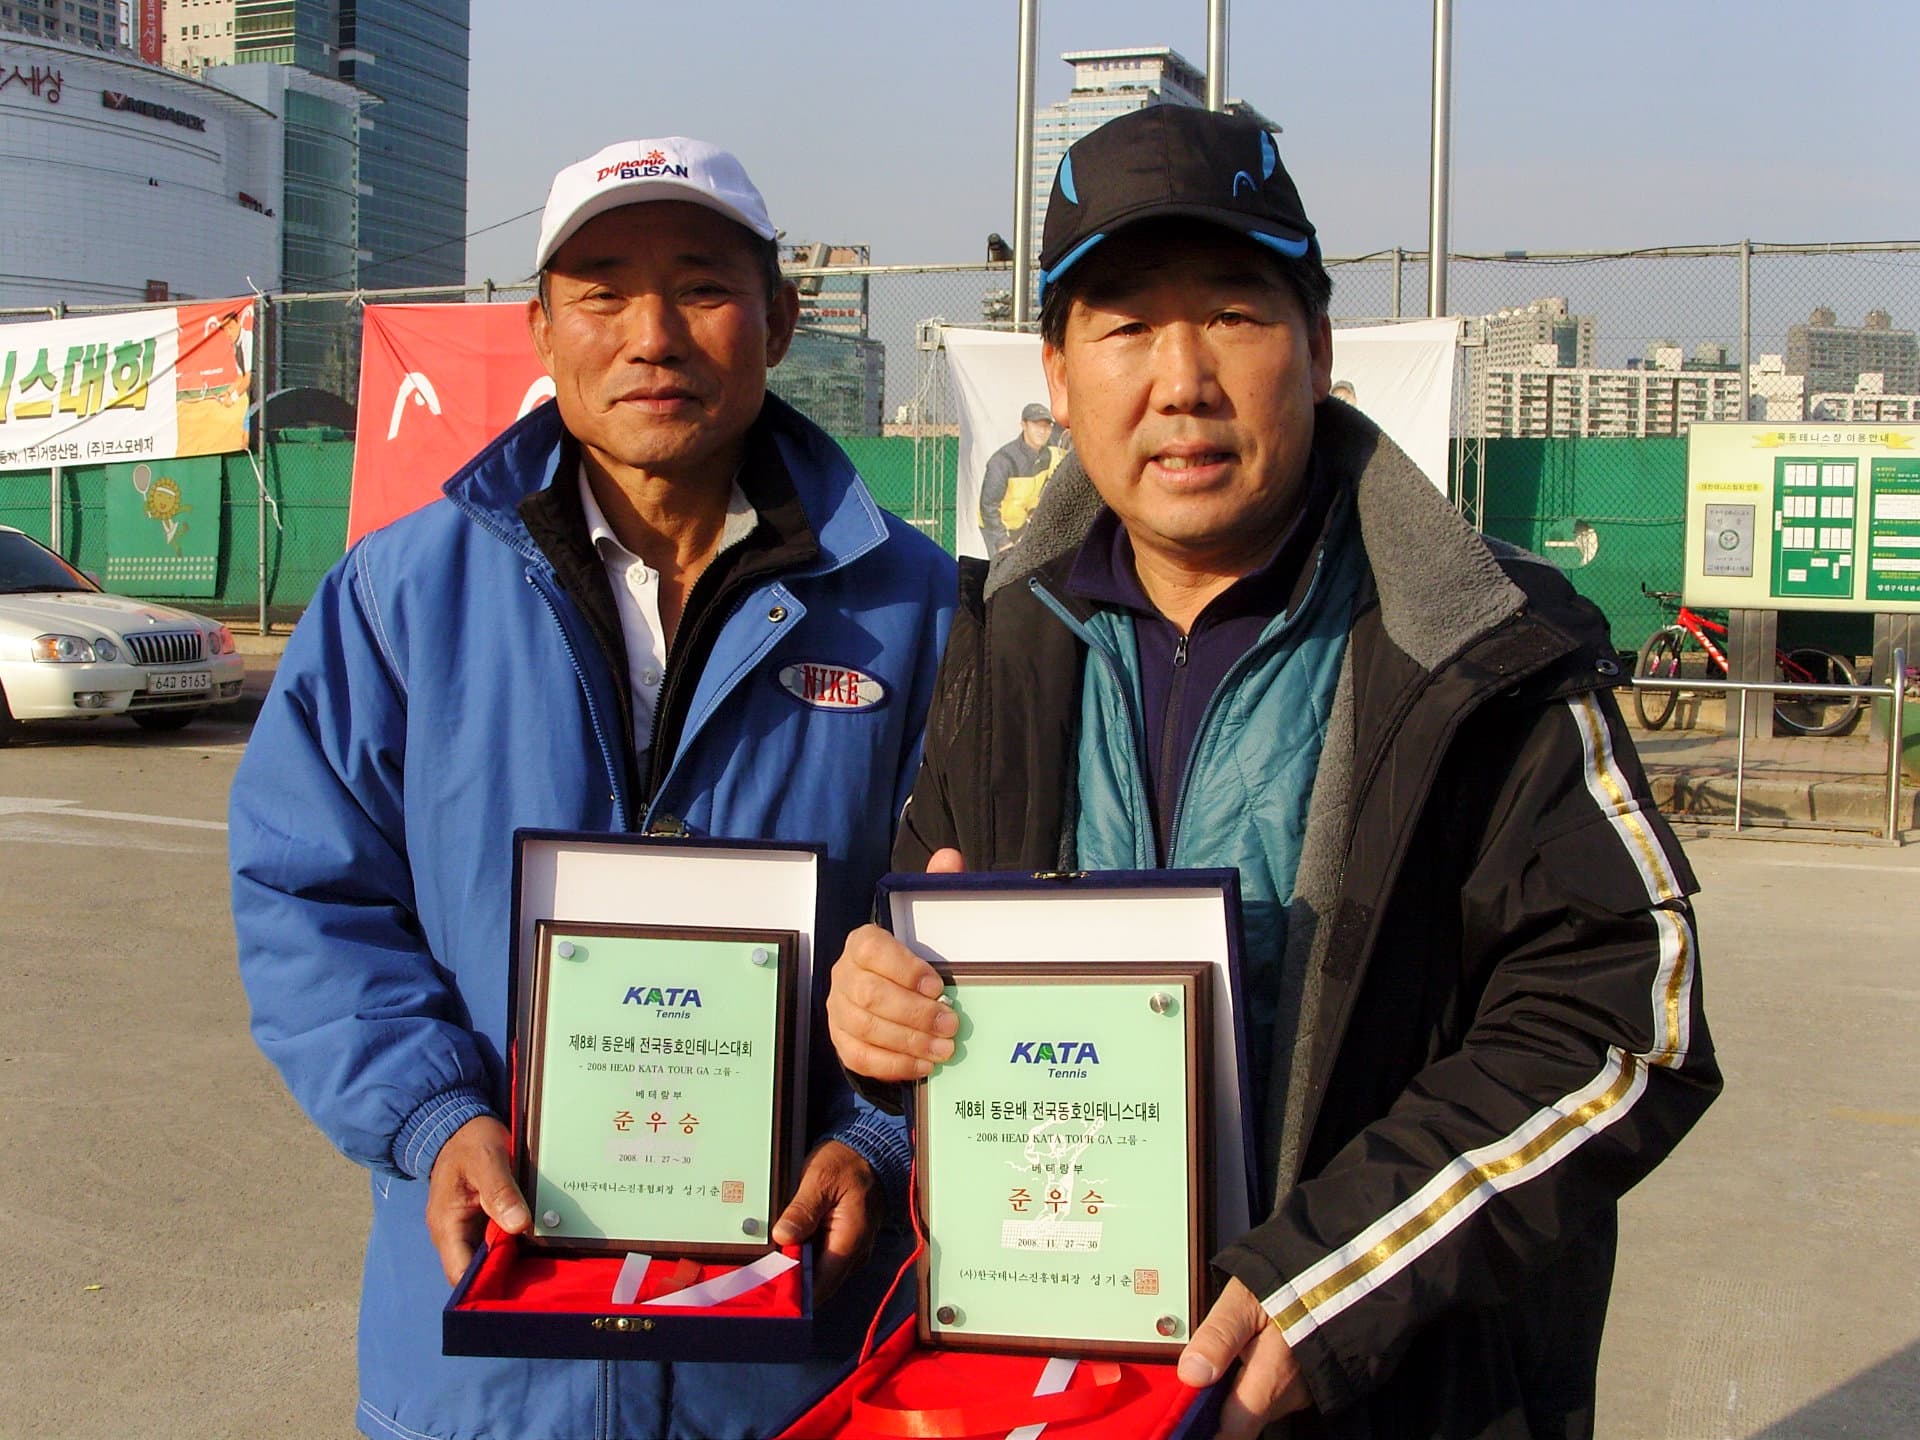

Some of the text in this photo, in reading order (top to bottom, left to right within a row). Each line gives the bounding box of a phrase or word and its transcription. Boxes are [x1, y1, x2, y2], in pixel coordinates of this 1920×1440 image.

[596, 157, 667, 182] Dynamic
[620, 164, 689, 180] BUSAN
[180, 674, 206, 688] 8163
[802, 665, 859, 705] NIKE
[622, 986, 702, 1008] KATA
[655, 1009, 691, 1020] Tennis
[568, 1033, 753, 1057] 제8회 동운배 전국동호인테니스대회
[1010, 1042, 1100, 1065] KATA
[587, 1062, 607, 1071] 2008
[610, 1064, 635, 1073] HEAD
[638, 1065, 664, 1074] KATA
[668, 1066, 693, 1075] TOUR
[696, 1067, 710, 1076] GA
[1048, 1067, 1088, 1079] Tennis
[954, 1099, 1160, 1123] 제8회 동운배 전국동호인테니스대회
[976, 1132, 999, 1142] 2008
[1001, 1133, 1029, 1143] HEAD
[1033, 1134, 1061, 1144] KATA
[1098, 1135, 1113, 1145] GA
[1116, 1135, 1137, 1146] 그룹
[960, 1268, 1081, 1286] (사)한국테니스진흥협회장
